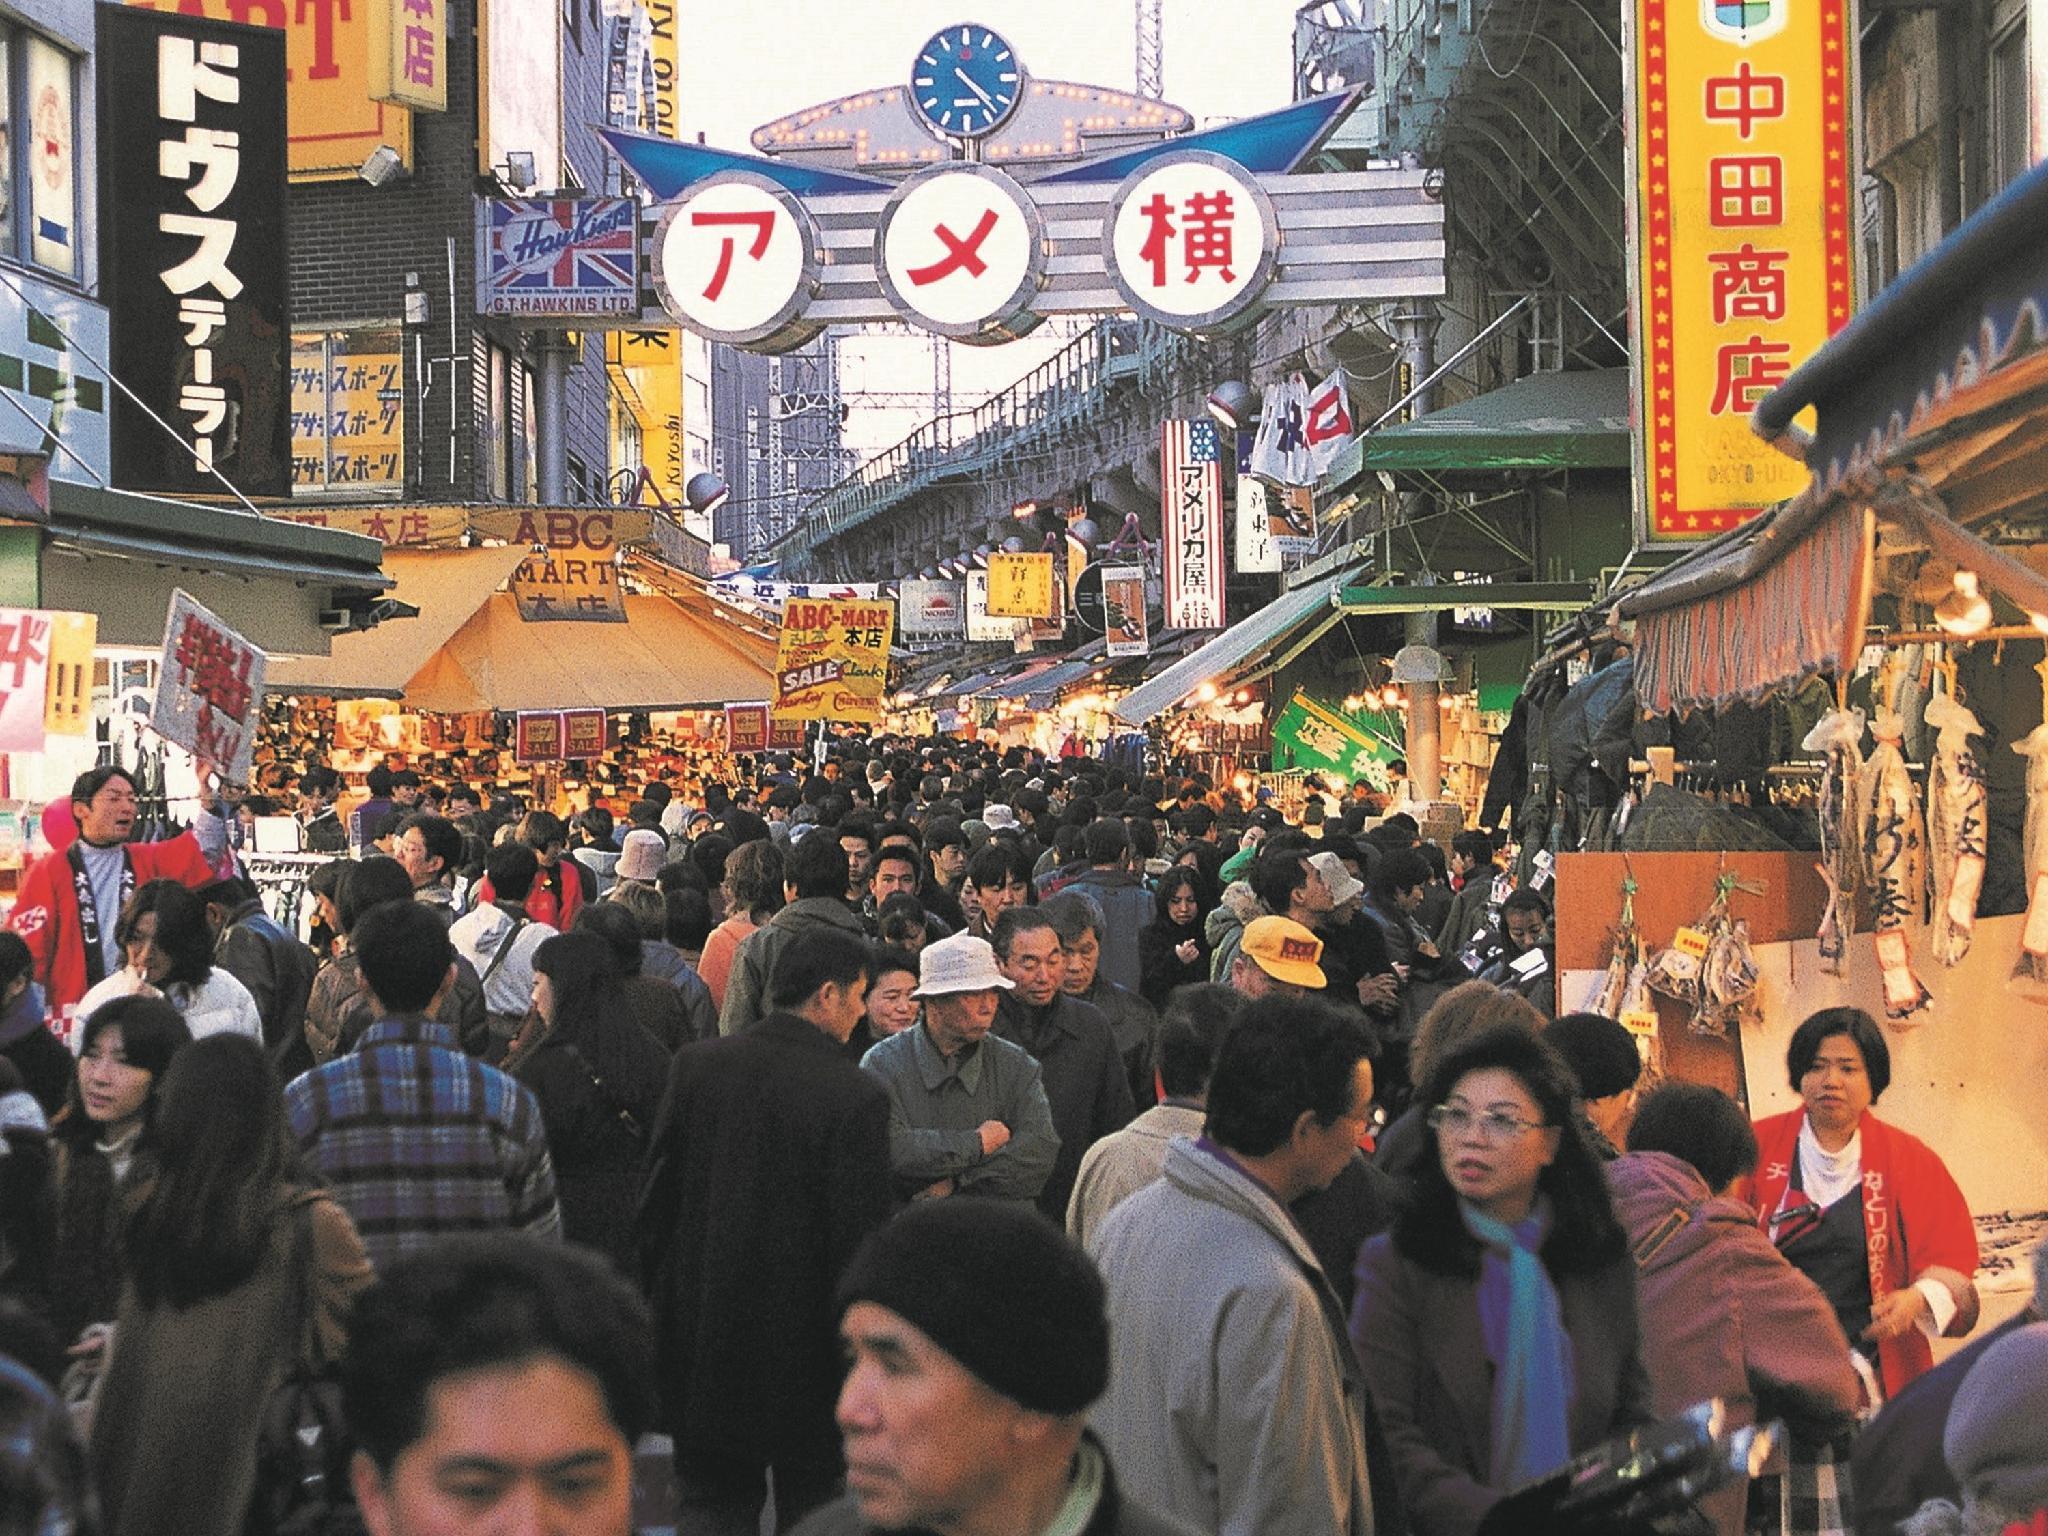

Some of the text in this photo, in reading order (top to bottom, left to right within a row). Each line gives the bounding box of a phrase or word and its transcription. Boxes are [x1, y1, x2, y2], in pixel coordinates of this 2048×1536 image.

[512, 201, 626, 262] Hawkins
[1705, 62, 1791, 416] 中田商店
[691, 190, 1237, 301] アメ横
[602, 296, 635, 312] LTD.
[512, 512, 613, 550] ABC
[1179, 466, 1207, 587] アメリカ屋
[514, 559, 615, 584] MART
[784, 604, 889, 631] ABC-MART
[844, 626, 884, 648] 本店
[783, 661, 840, 692] SALE
[523, 742, 558, 756] SALE
[568, 739, 601, 753] SALE
[733, 733, 764, 746] SALE
[772, 731, 803, 743] SALE
